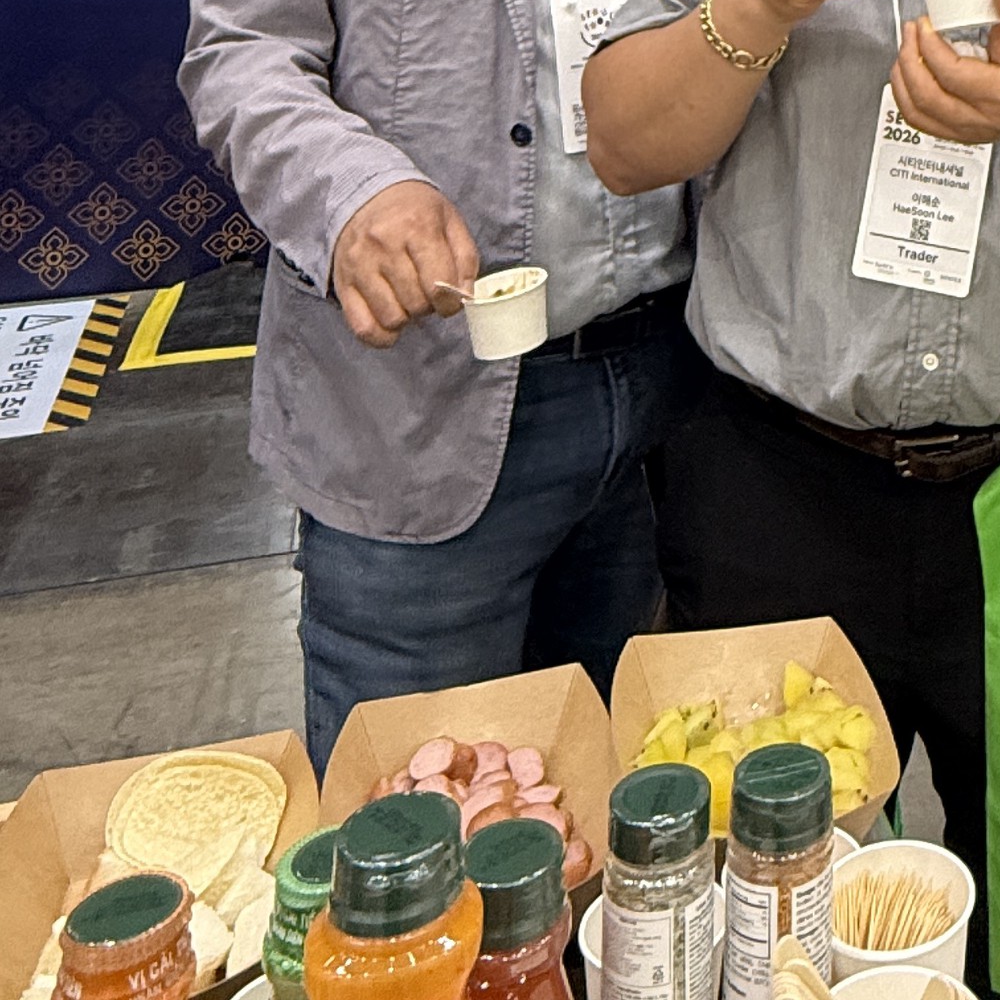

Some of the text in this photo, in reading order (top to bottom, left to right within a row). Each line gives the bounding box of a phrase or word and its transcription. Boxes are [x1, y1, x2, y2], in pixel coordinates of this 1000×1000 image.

[883, 126, 921, 145] 2026
[911, 172, 970, 190] International
[893, 202, 955, 223] HaeSoon Lee
[897, 245, 939, 264] Trader
